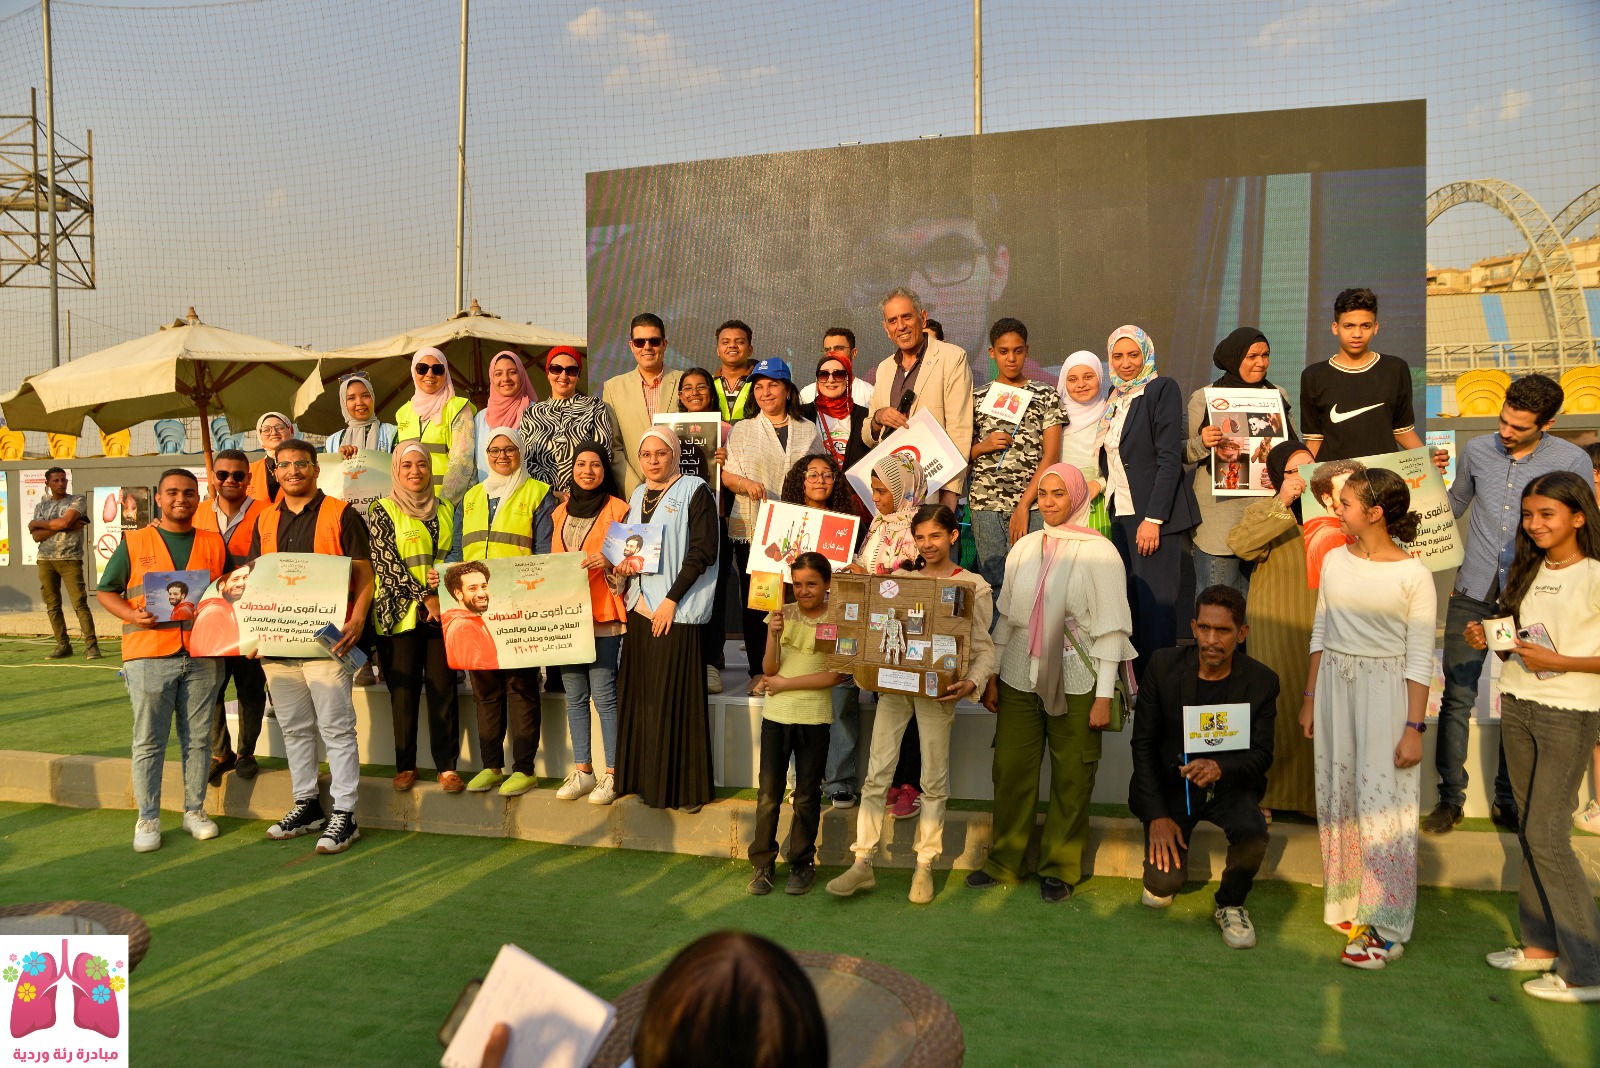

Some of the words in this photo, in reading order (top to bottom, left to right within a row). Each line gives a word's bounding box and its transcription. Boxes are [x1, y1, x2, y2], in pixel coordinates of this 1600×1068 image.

[923, 458, 939, 473] KING
[925, 463, 944, 479] PING
[240, 602, 277, 611] المخدرات
[278, 603, 292, 613] من
[293, 603, 318, 614] أقوى
[319, 603, 337, 614] أنت
[540, 605, 563, 618] أقوى
[565, 603, 582, 615] أنت
[488, 610, 523, 621] المخدرات
[524, 610, 538, 620] من
[496, 626, 527, 635] وبالمجان
[560, 622, 580, 631] العلاج
[258, 633, 284, 642] ١٦٠٢٣
[544, 633, 572, 641] للمشورة
[513, 644, 539, 654] ١٦٠٢٣
[542, 644, 555, 652] على
[555, 642, 573, 650] اتصل
